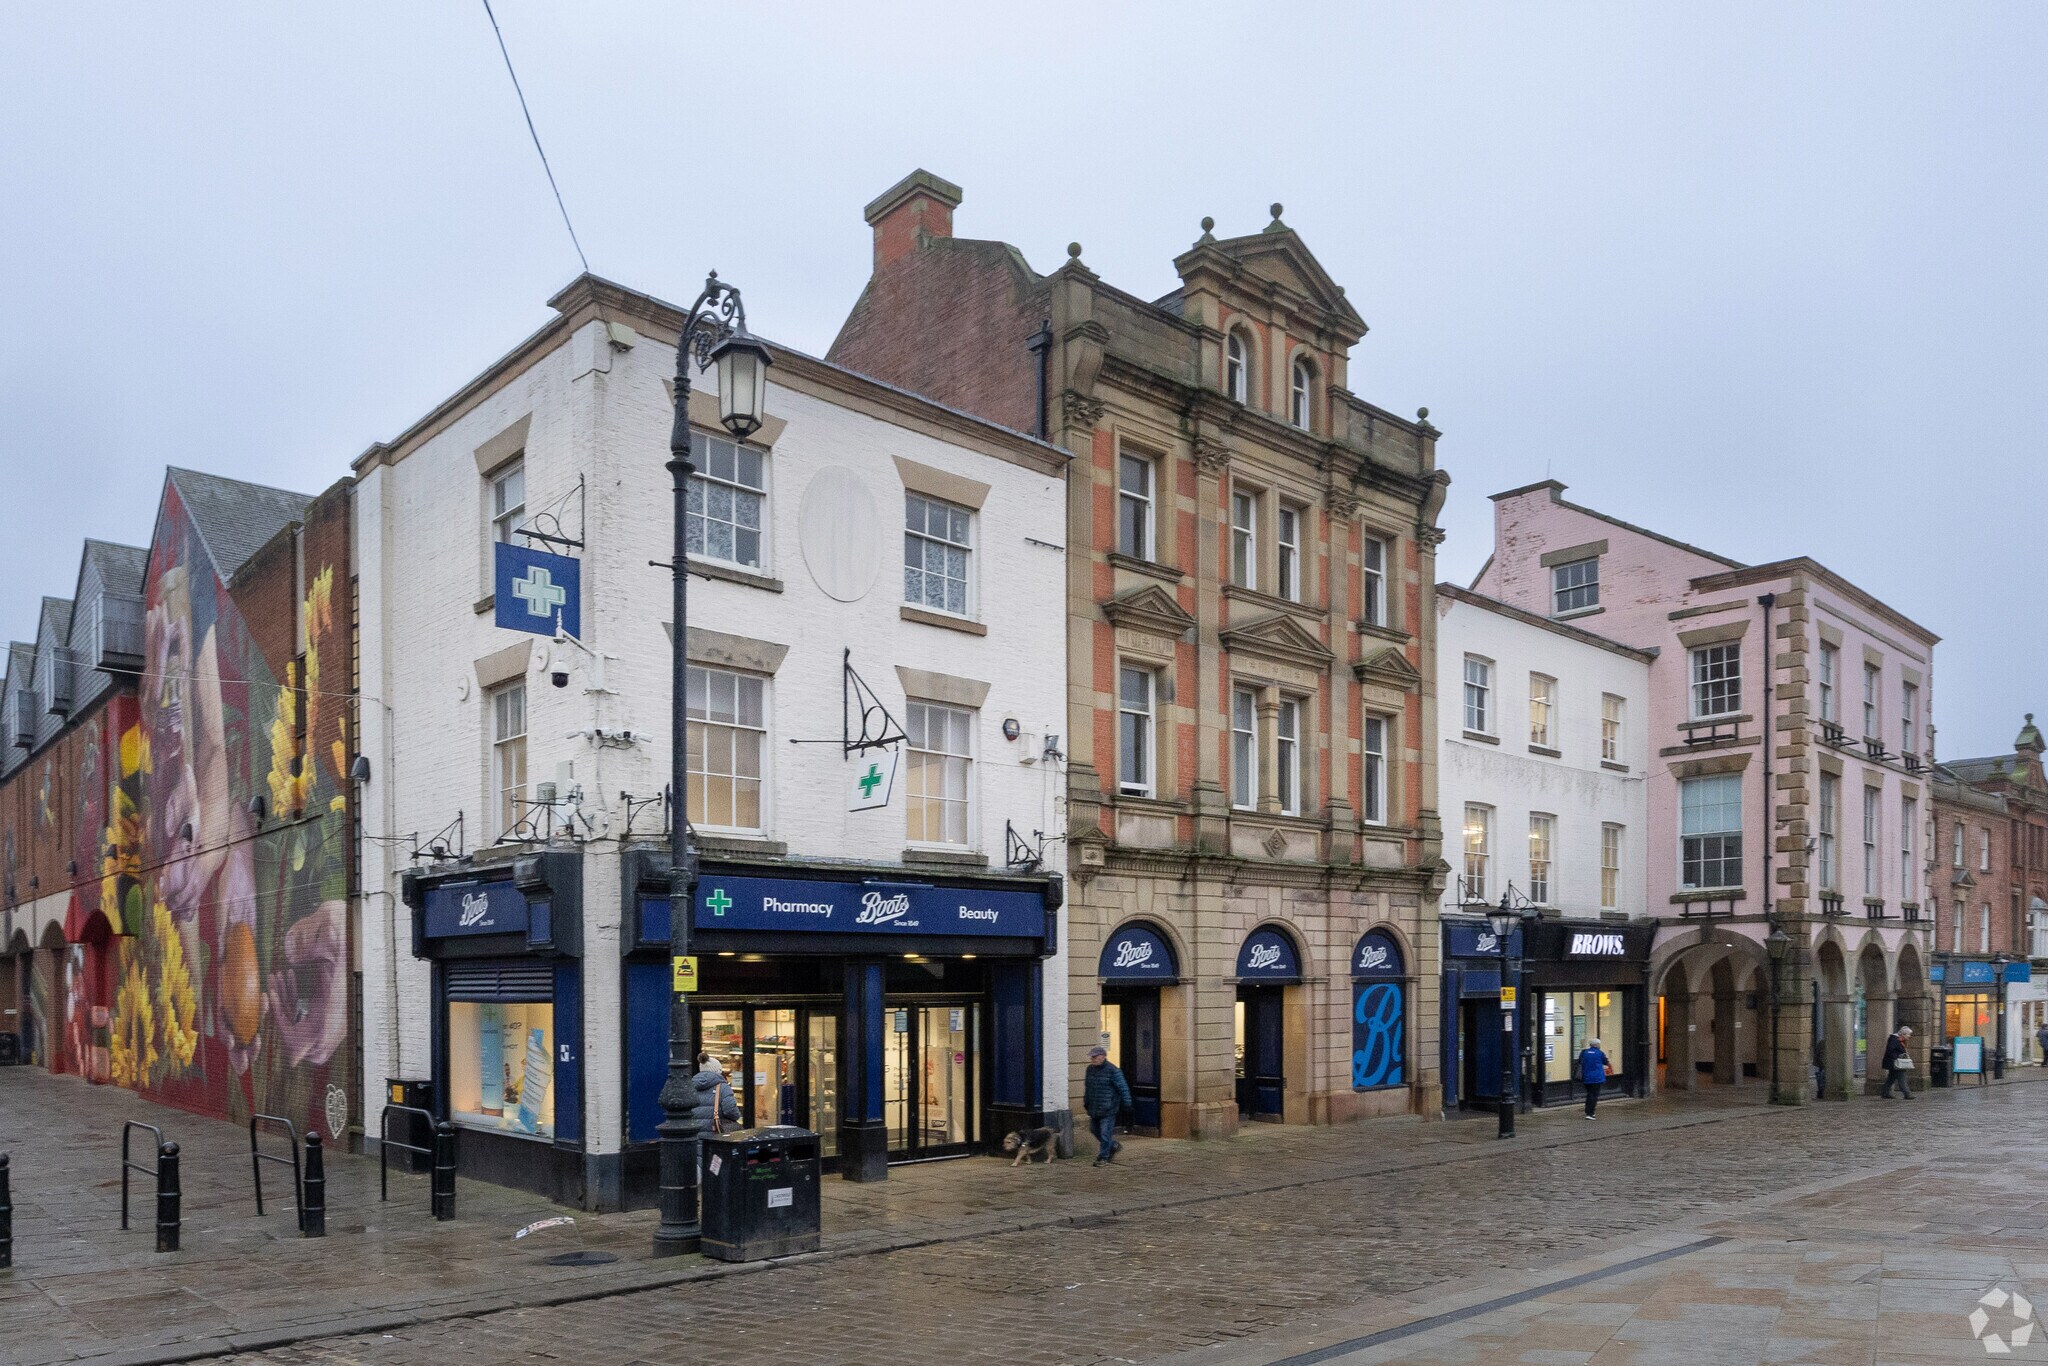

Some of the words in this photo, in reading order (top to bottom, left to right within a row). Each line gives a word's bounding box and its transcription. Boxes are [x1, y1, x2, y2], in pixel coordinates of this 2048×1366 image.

[763, 897, 834, 918] Pharmacy
[855, 891, 910, 925] Boots
[959, 906, 999, 923] Beauty
[1113, 941, 1152, 968] Boots
[1570, 933, 1625, 955] BROWS.
[1247, 944, 1281, 969] Boots
[1359, 946, 1387, 968] Boots
